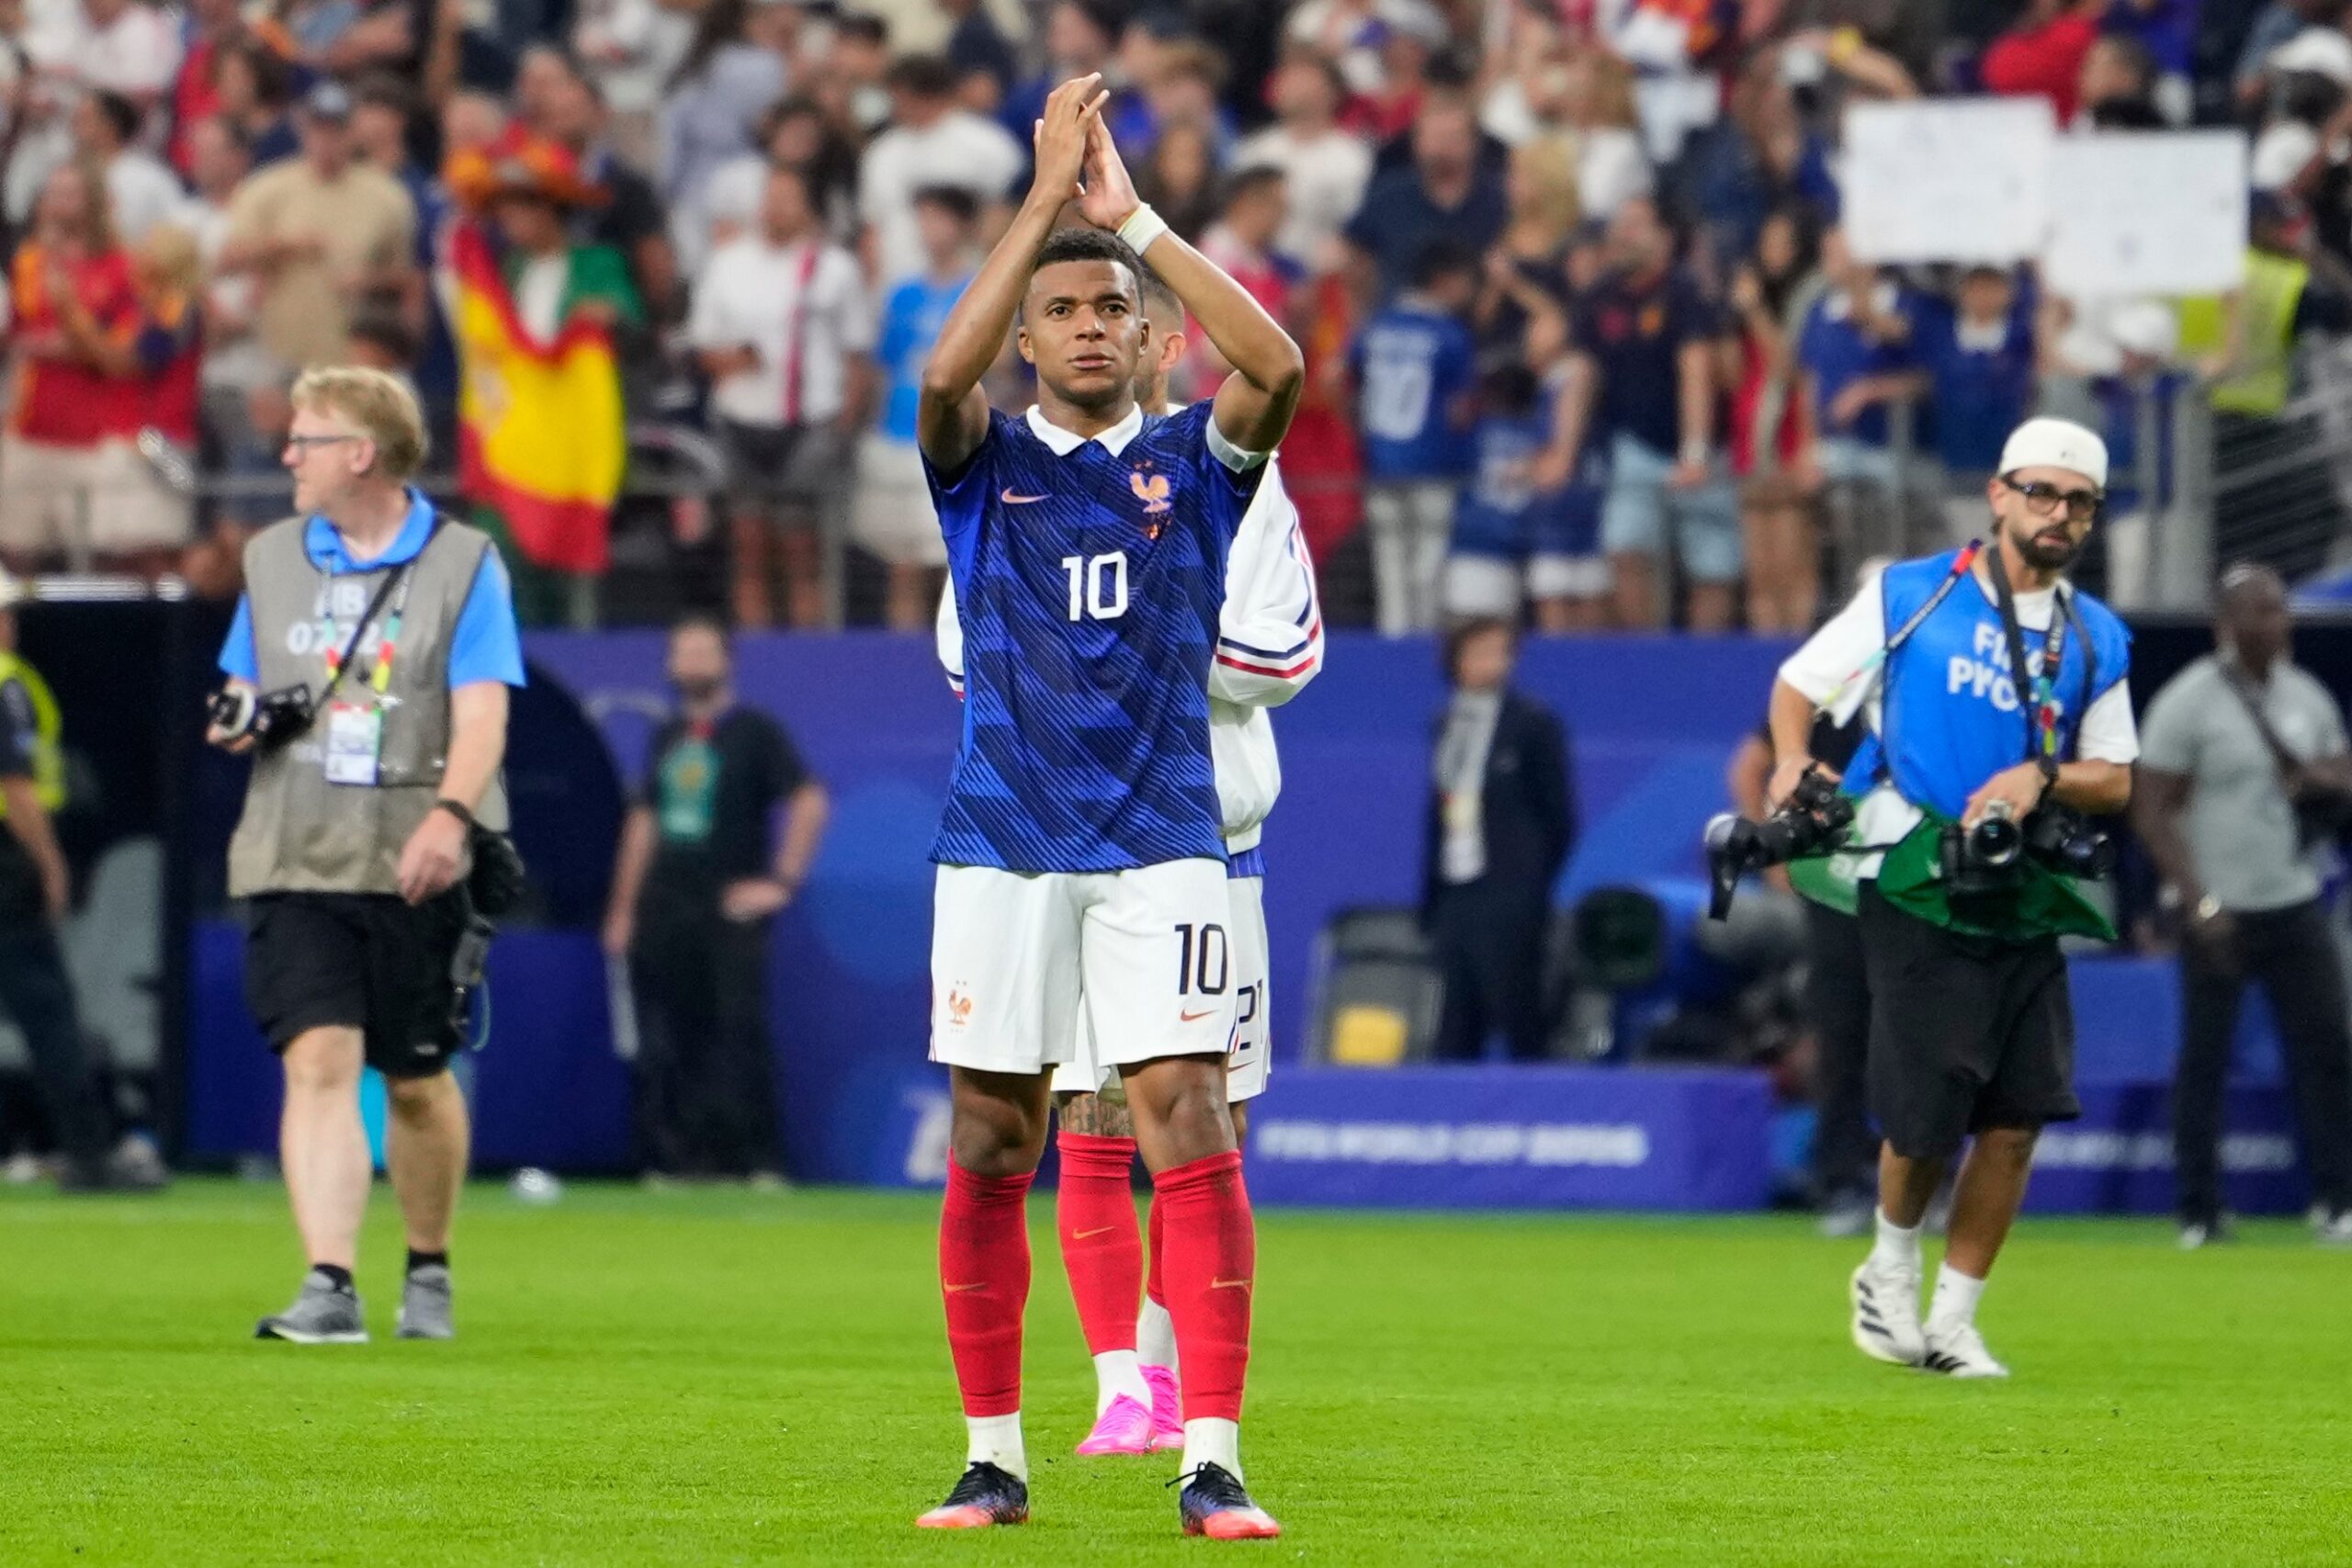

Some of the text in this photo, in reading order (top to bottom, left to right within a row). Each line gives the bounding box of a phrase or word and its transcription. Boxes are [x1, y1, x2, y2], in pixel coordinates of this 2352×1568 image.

[1062, 550, 1128, 622] 10
[1174, 923, 1227, 996] 10
[1238, 978, 1263, 1050] 21
